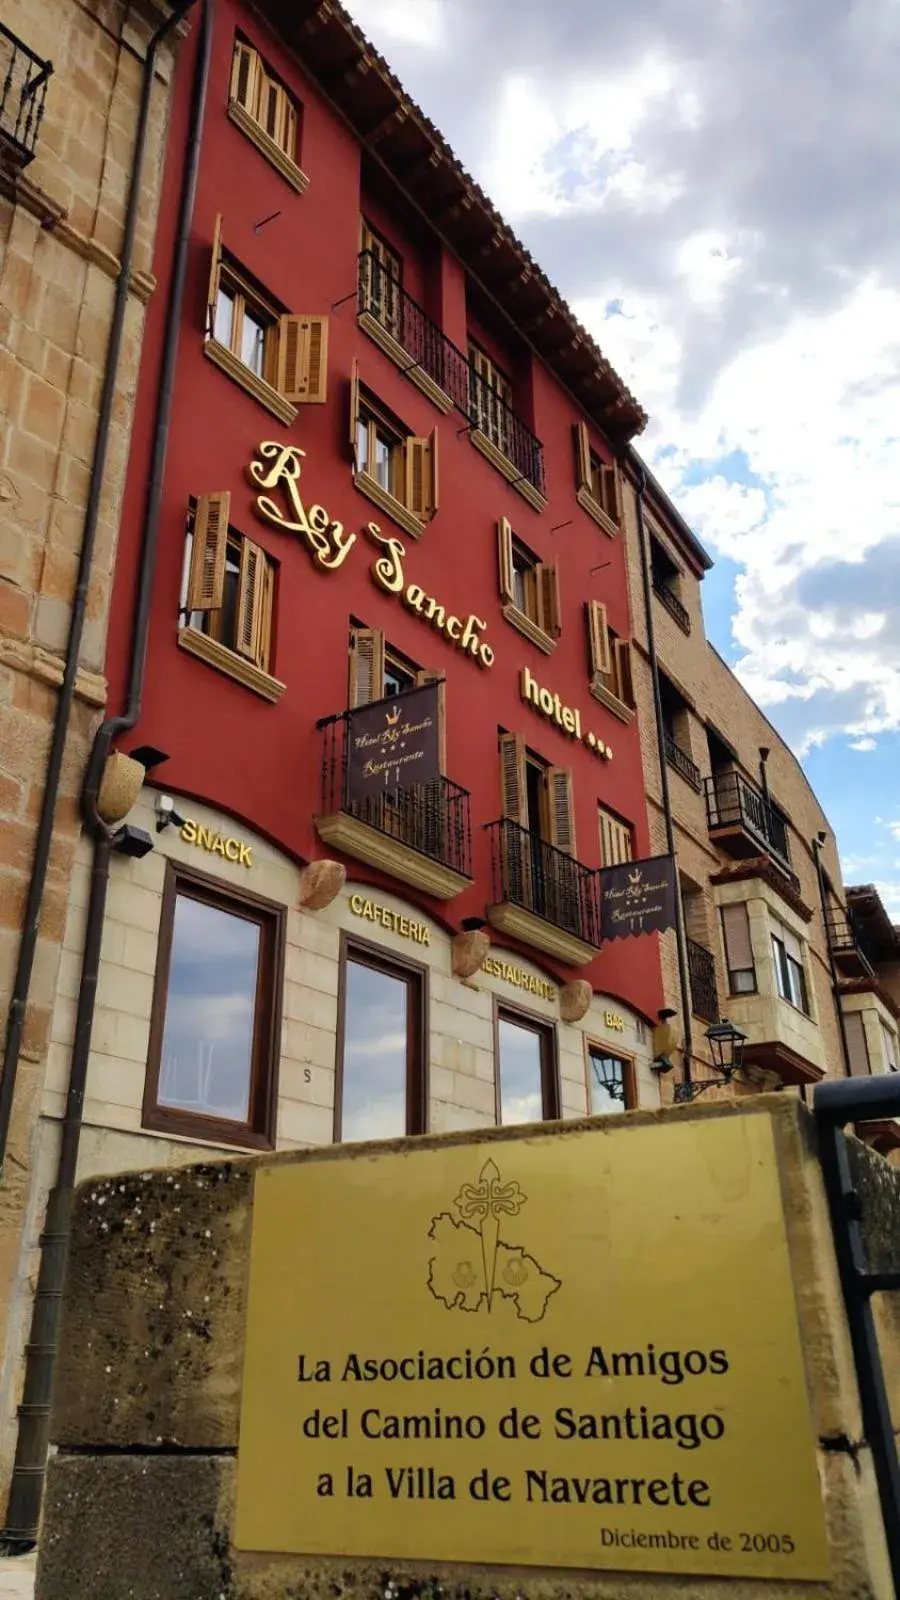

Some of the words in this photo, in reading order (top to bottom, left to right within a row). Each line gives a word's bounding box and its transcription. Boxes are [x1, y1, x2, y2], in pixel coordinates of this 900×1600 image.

[248, 440, 356, 569] Rey
[366, 521, 496, 669] Sancho
[520, 666, 582, 741] hotel
[363, 751, 424, 778] Restaurante
[179, 818, 253, 868] SNACK
[349, 894, 432, 946] CAFETERIA
[482, 957, 556, 1002] ESTAURANTE
[604, 1010, 625, 1033] BAR
[297, 1354, 332, 1383] La
[340, 1346, 517, 1382] Asociación
[529, 1346, 573, 1379] de
[583, 1343, 730, 1386] Amigos
[302, 1408, 349, 1440] del
[360, 1407, 487, 1440] Camino
[498, 1406, 542, 1440] de
[554, 1405, 726, 1451] Santiago
[316, 1471, 335, 1498] a
[346, 1465, 374, 1500] la
[384, 1466, 457, 1501] Villa
[468, 1467, 512, 1503] de
[524, 1469, 713, 1508] Navarrete
[600, 1527, 700, 1551] Diciembre
[706, 1530, 733, 1552] de
[739, 1532, 796, 1554] 2005
